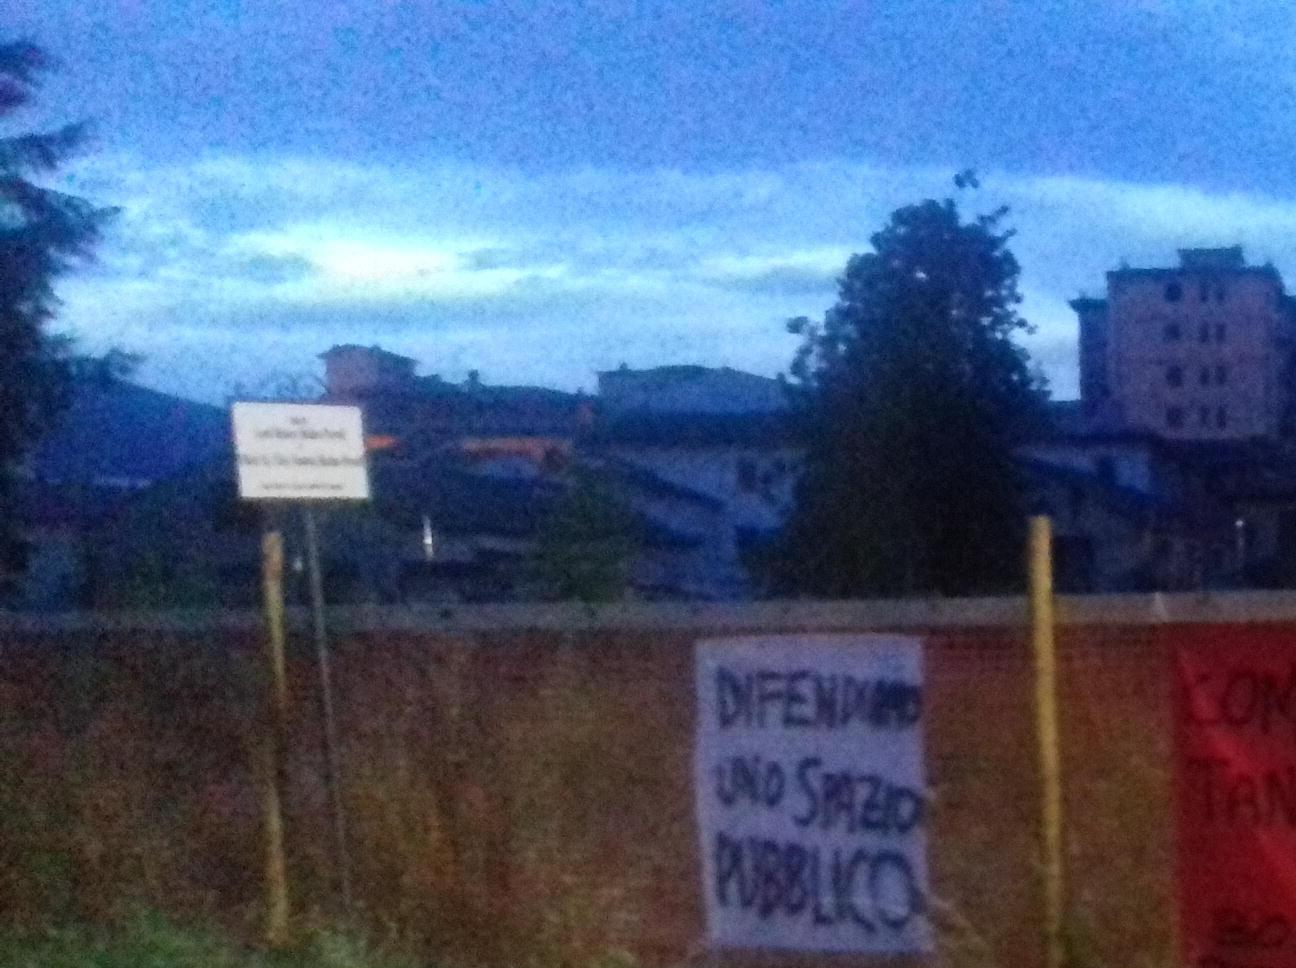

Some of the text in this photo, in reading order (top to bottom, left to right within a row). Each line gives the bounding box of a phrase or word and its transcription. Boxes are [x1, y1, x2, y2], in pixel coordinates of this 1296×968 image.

[713, 755, 925, 835] UNO SPAZIO
[714, 831, 924, 935] PUBBLICO
